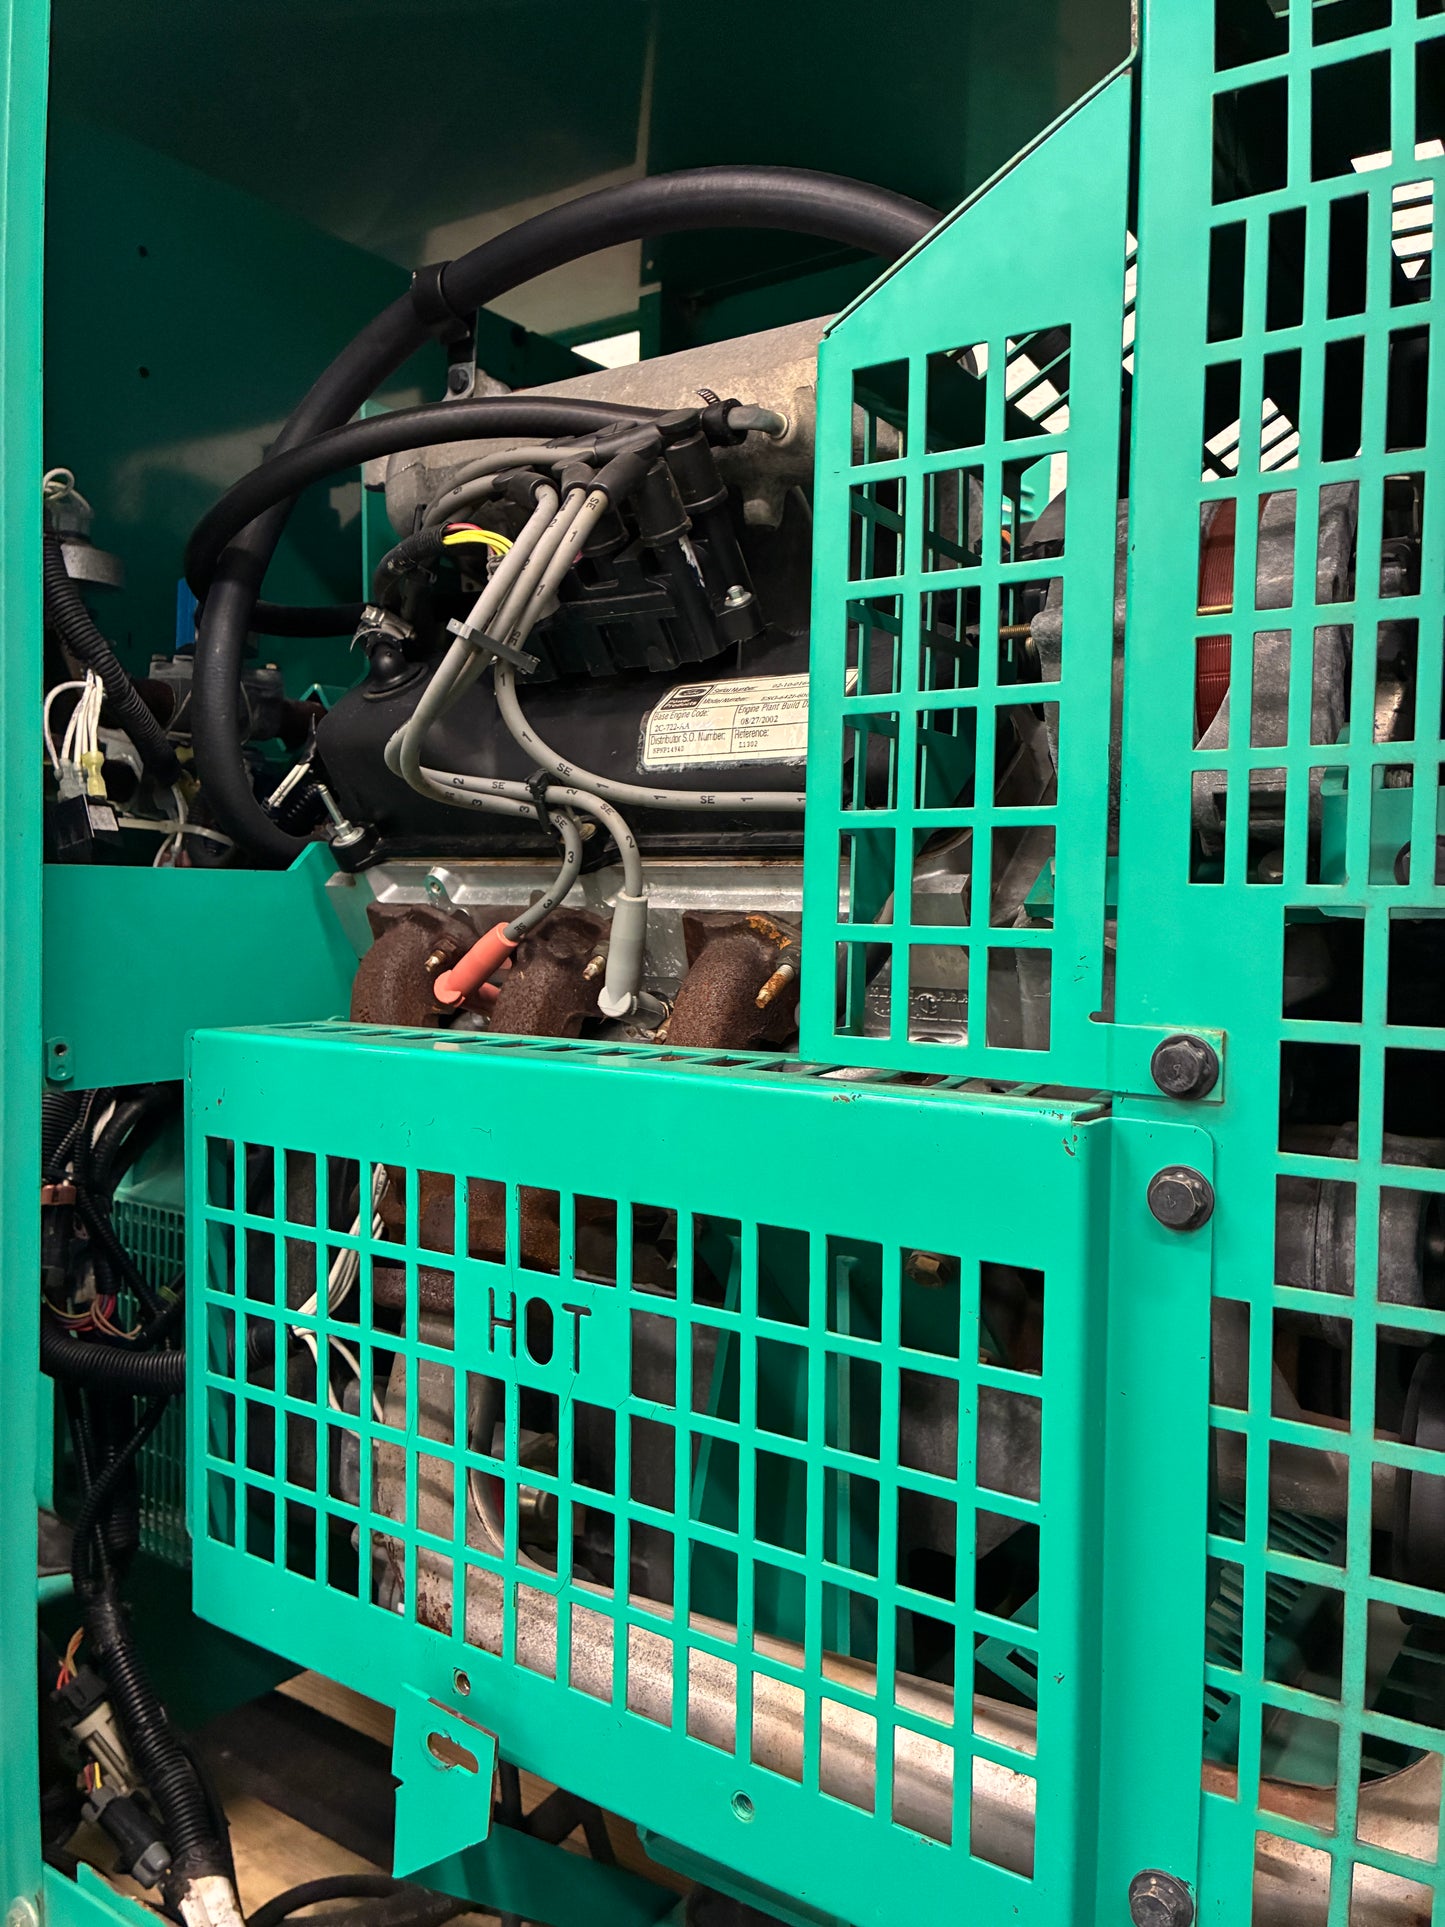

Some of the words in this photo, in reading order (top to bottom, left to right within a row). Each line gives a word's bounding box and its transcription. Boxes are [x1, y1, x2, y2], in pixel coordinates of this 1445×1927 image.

[653, 712, 669, 721] Base
[671, 710, 691, 721] Engine
[691, 709, 709, 718] Code:
[738, 703, 760, 715] Engine
[761, 702, 780, 712] Plant
[781, 701, 800, 710] Build
[740, 715, 779, 725] 08/27/2002
[650, 734, 682, 746] Distributor
[734, 729, 769, 739] Reference:
[556, 762, 573, 777] SE
[700, 795, 716, 805] SE
[492, 781, 506, 790] SE
[600, 803, 615, 816] SE
[626, 835, 635, 849] 2
[554, 815, 568, 829] SE
[567, 851, 575, 864] 3
[488, 1287, 592, 1374] HOT
